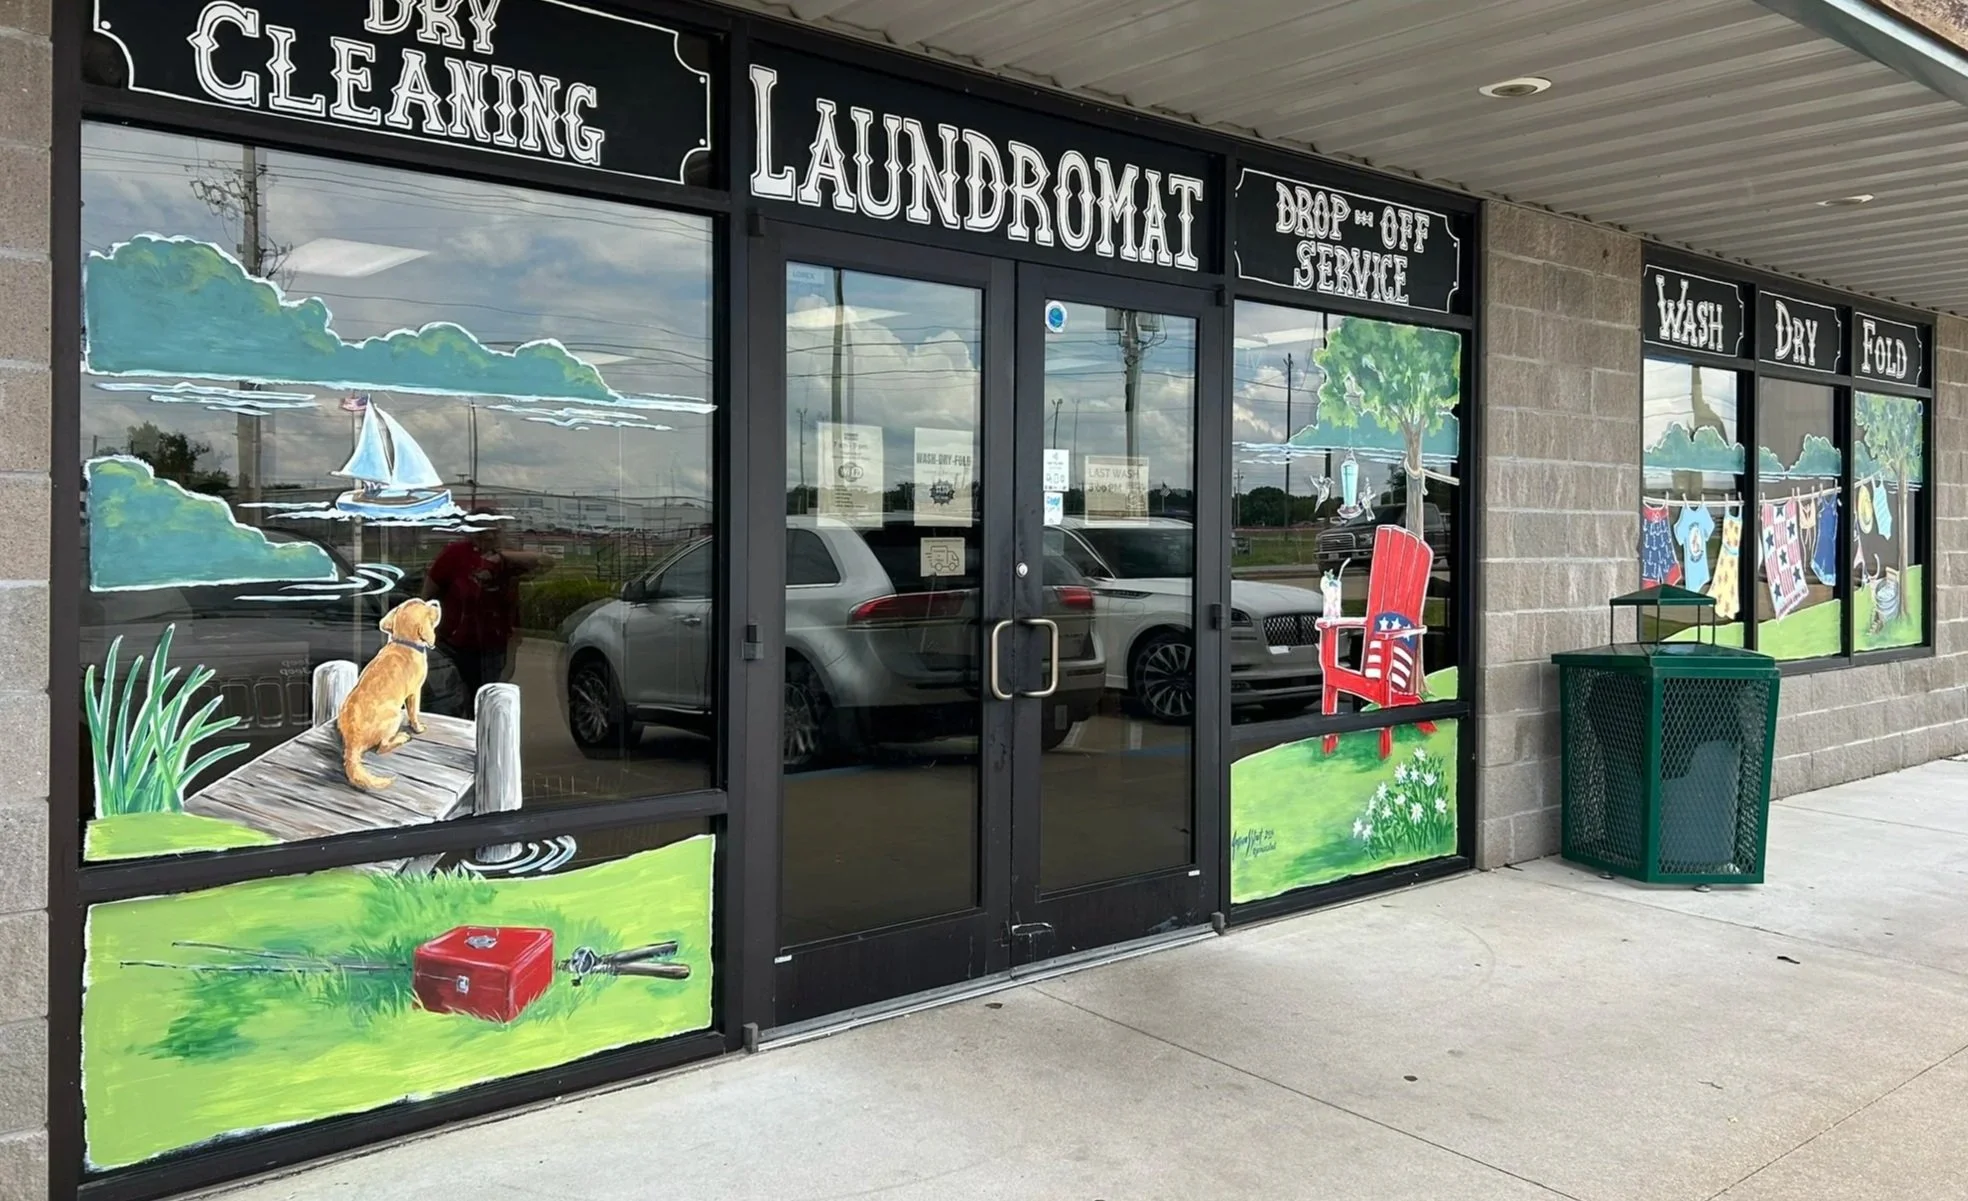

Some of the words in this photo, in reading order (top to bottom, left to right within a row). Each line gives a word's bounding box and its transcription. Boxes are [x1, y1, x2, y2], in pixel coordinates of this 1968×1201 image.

[187, 0, 605, 166] CLEANING
[748, 64, 1203, 271] LAUNDROMAT
[1275, 181, 1351, 241] DROP
[1379, 205, 1430, 253] OFF
[1293, 240, 1409, 307] SERVICE
[1655, 275, 1724, 351] WASH
[1775, 300, 1818, 366] DRY
[1861, 318, 1908, 379] FOLD
[1089, 468, 1110, 478] LAST
[1111, 468, 1140, 480] WASH
